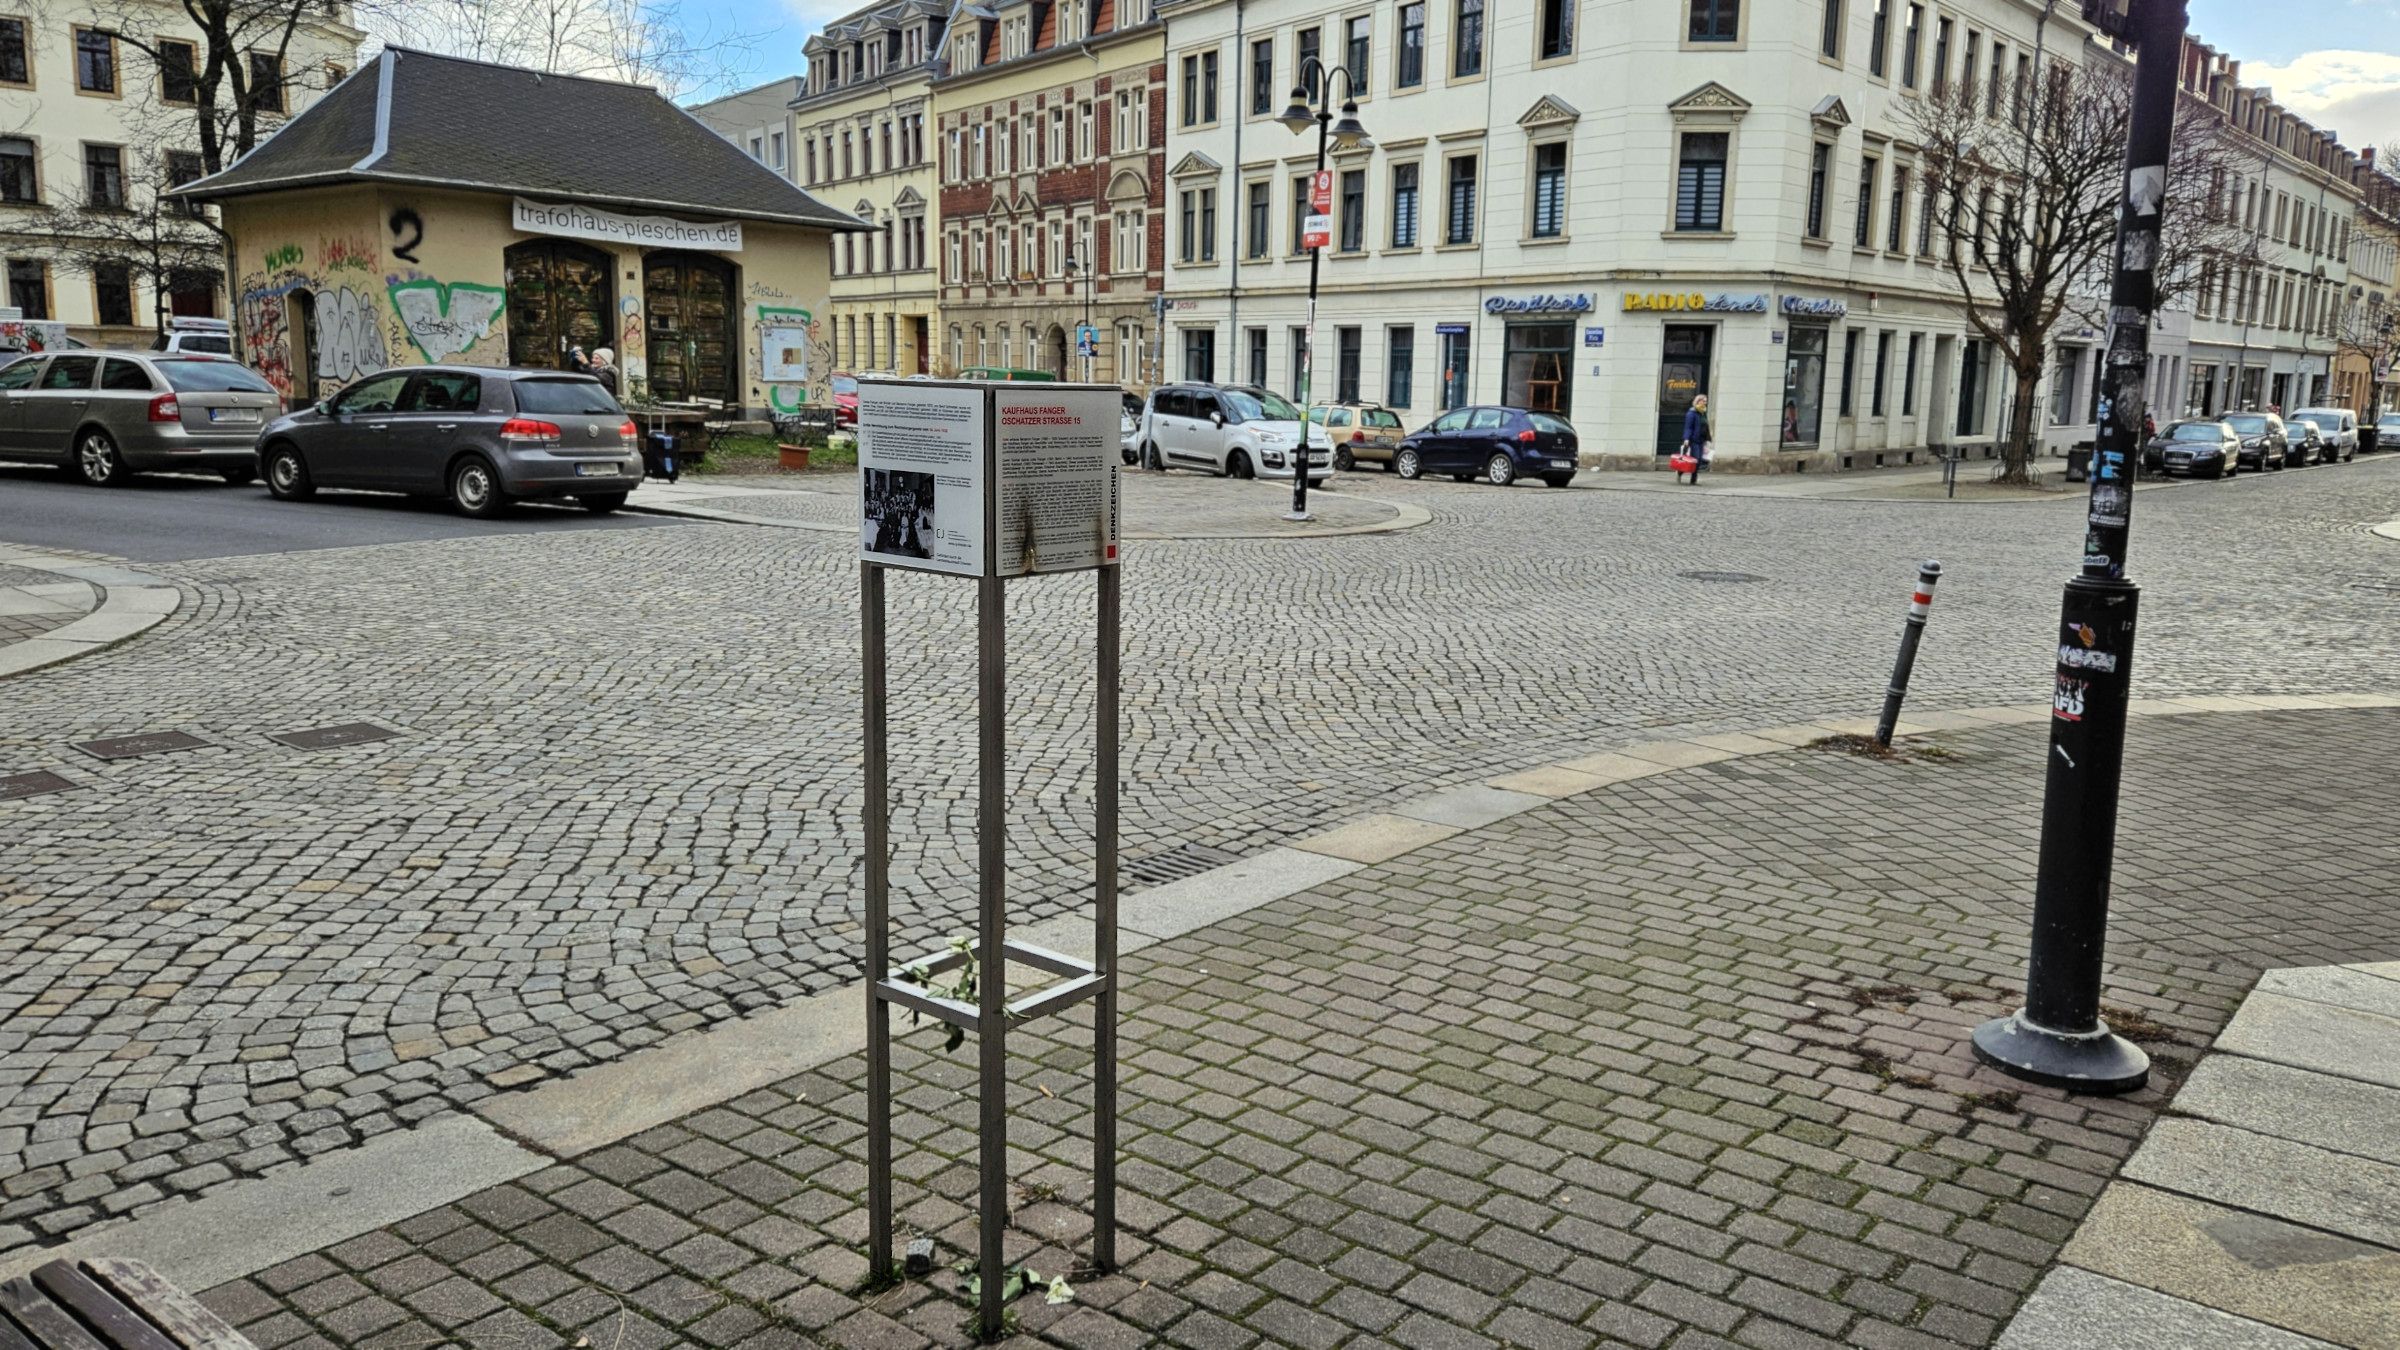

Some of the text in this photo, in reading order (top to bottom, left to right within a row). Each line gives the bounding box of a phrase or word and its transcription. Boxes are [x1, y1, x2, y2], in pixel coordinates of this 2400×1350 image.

[519, 203, 738, 243] trafohaus-pieschen.de
[389, 207, 423, 264] 2
[1485, 293, 1591, 313] Rundfunk
[1623, 292, 1705, 311] RADIO
[1001, 406, 1066, 415] KAUFHAUS FANGER
[1001, 417, 1042, 425] OSCHATZER
[1042, 417, 1072, 425] STRASSE
